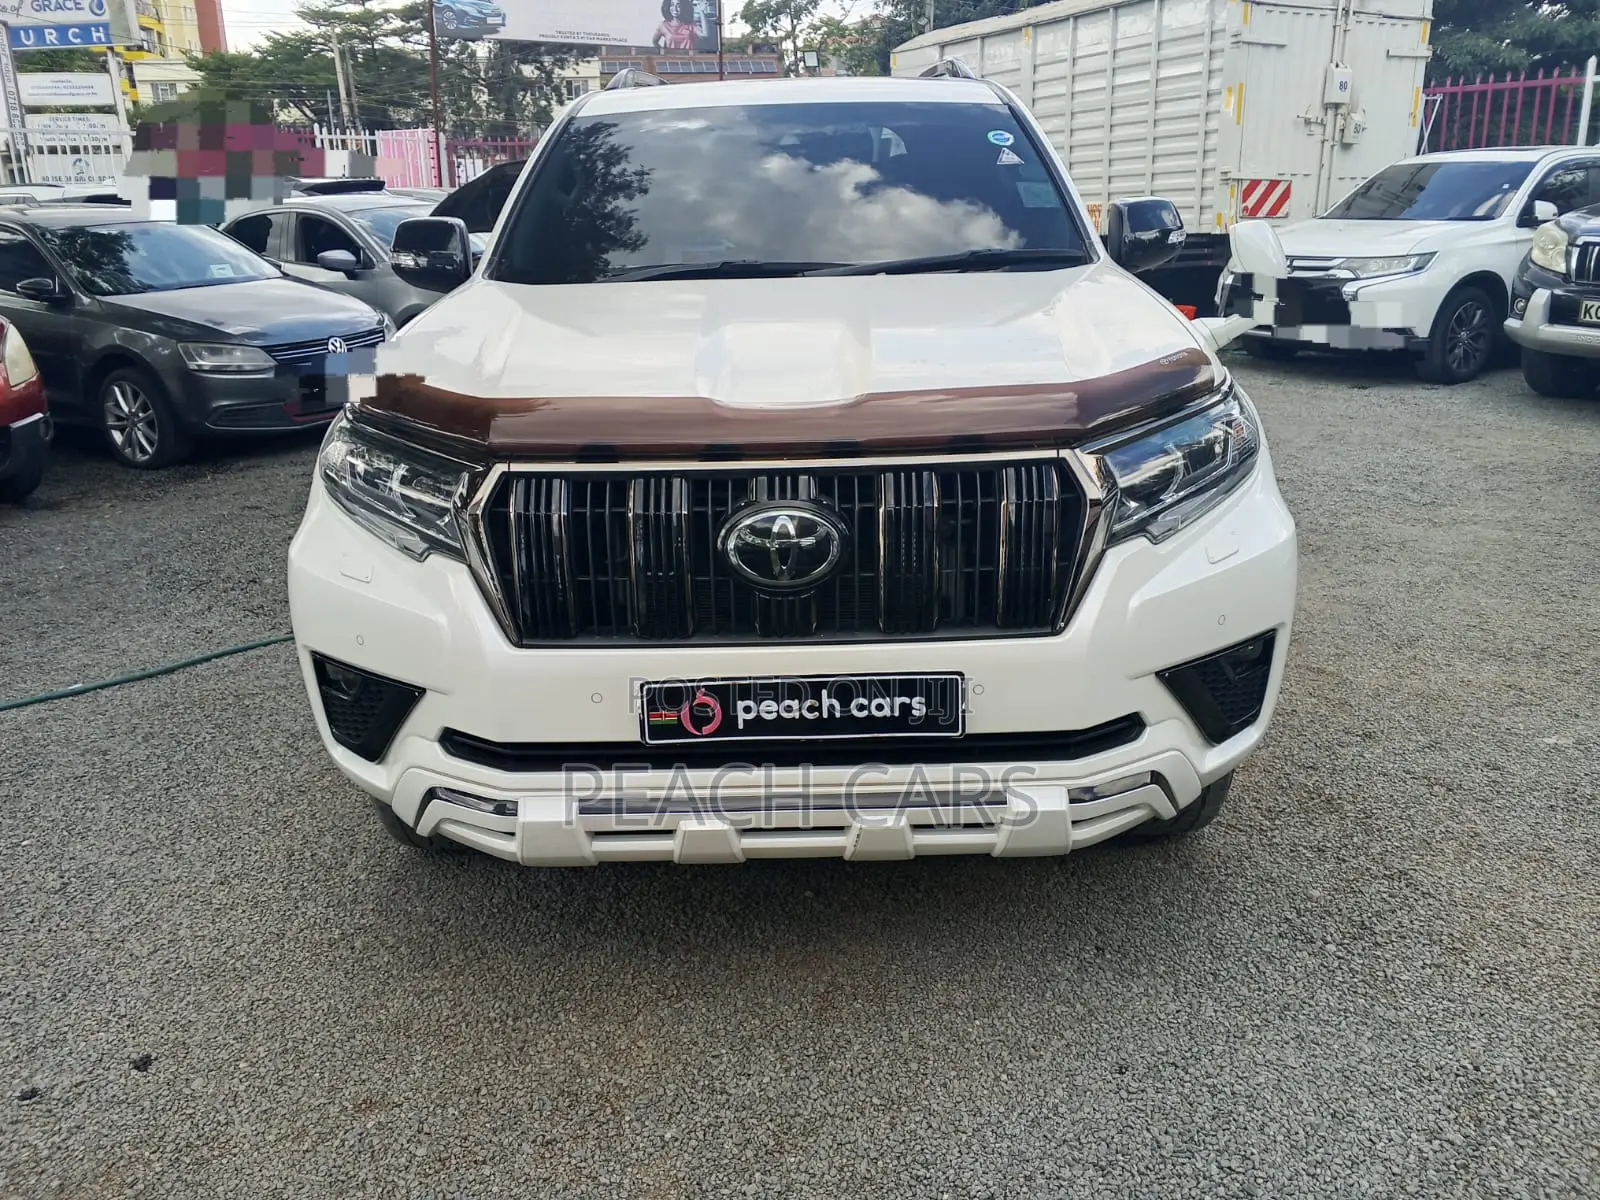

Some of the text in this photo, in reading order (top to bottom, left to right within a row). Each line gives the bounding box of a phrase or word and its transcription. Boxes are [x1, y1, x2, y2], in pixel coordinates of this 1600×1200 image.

[31, 0, 85, 12] GRACE
[1339, 80, 1348, 90] 80
[736, 688, 927, 730] peach cars
